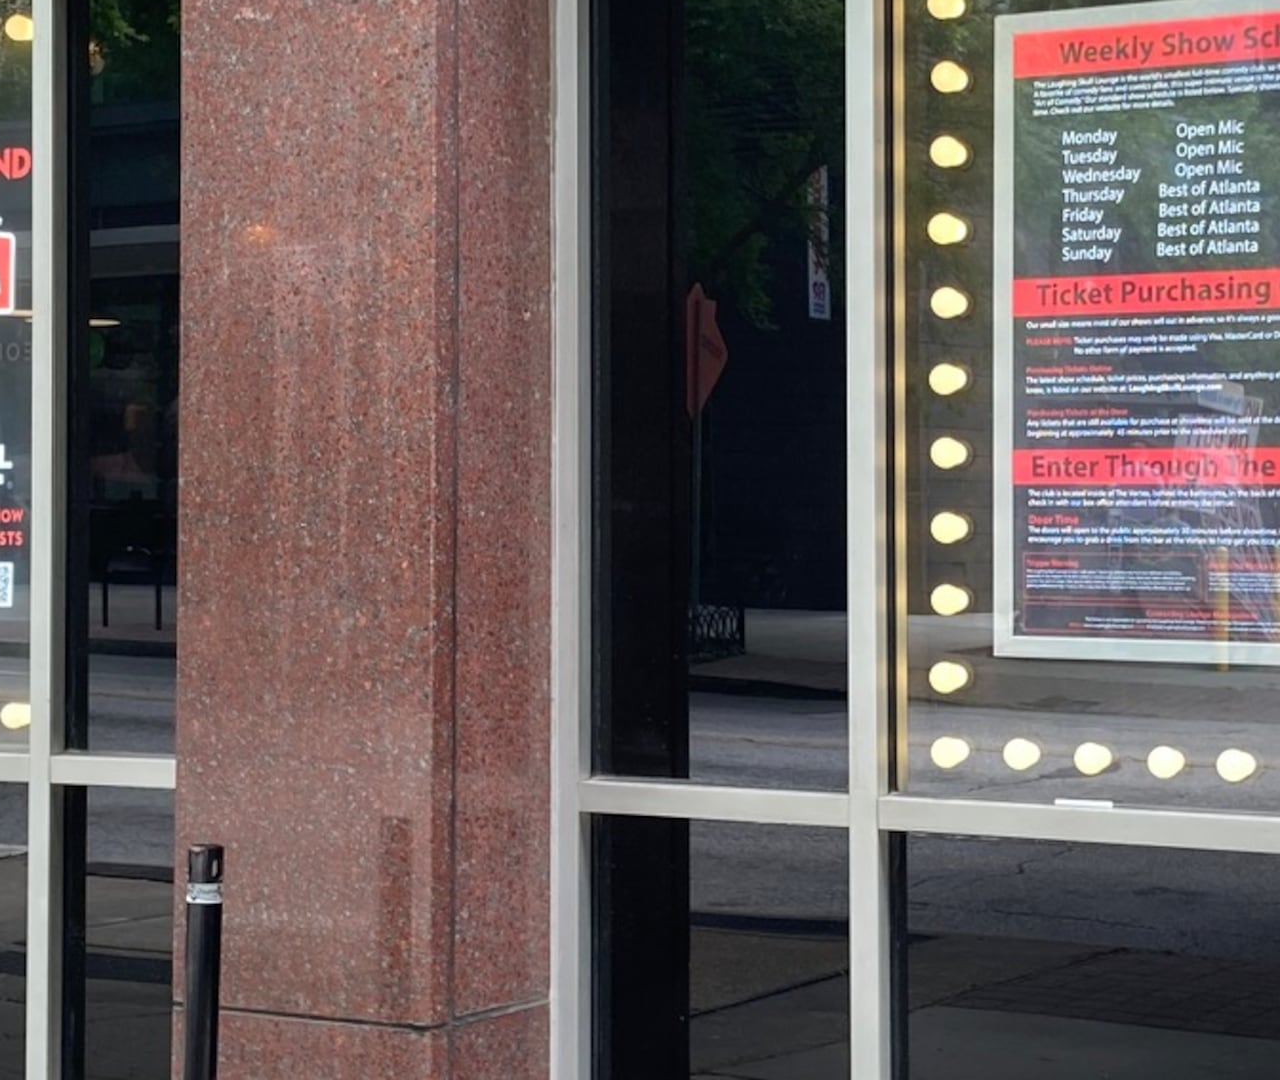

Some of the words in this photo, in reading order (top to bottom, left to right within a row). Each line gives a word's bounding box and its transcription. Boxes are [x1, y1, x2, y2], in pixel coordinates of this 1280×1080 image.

[1059, 37, 1153, 65] Weekly
[1163, 29, 1233, 56] Show
[1062, 129, 1117, 147] Monday
[1176, 123, 1213, 139] Open
[1219, 120, 1244, 135] Mic
[1062, 149, 1117, 167] Tuesday
[1176, 143, 1213, 159] Open
[1219, 140, 1244, 155] Mic
[1062, 166, 1141, 185] Wednesday
[1175, 163, 1212, 180] Open
[1218, 160, 1243, 175] Mic
[1062, 187, 1124, 205] Thursday
[1159, 182, 1189, 198] Best
[1192, 181, 1207, 196] of
[1208, 178, 1260, 195] Atlanta
[1062, 207, 1103, 226] Friday
[1159, 203, 1189, 218] Best
[1192, 201, 1207, 216] of
[1208, 198, 1260, 215] Atlanta
[1062, 226, 1121, 244] Saturday
[1158, 222, 1188, 238] Best
[1191, 221, 1206, 235] of
[1207, 218, 1260, 234] Atlanta
[1062, 246, 1112, 264] Sunday
[1157, 242, 1187, 257] Best
[1190, 241, 1205, 256] of
[1207, 239, 1258, 255] Atlanta
[1036, 283, 1113, 306] Ticket
[1121, 278, 1271, 304] Purchasing
[1031, 456, 1099, 477] Enter
[1105, 455, 1219, 481] Through
[1228, 455, 1275, 476] The
